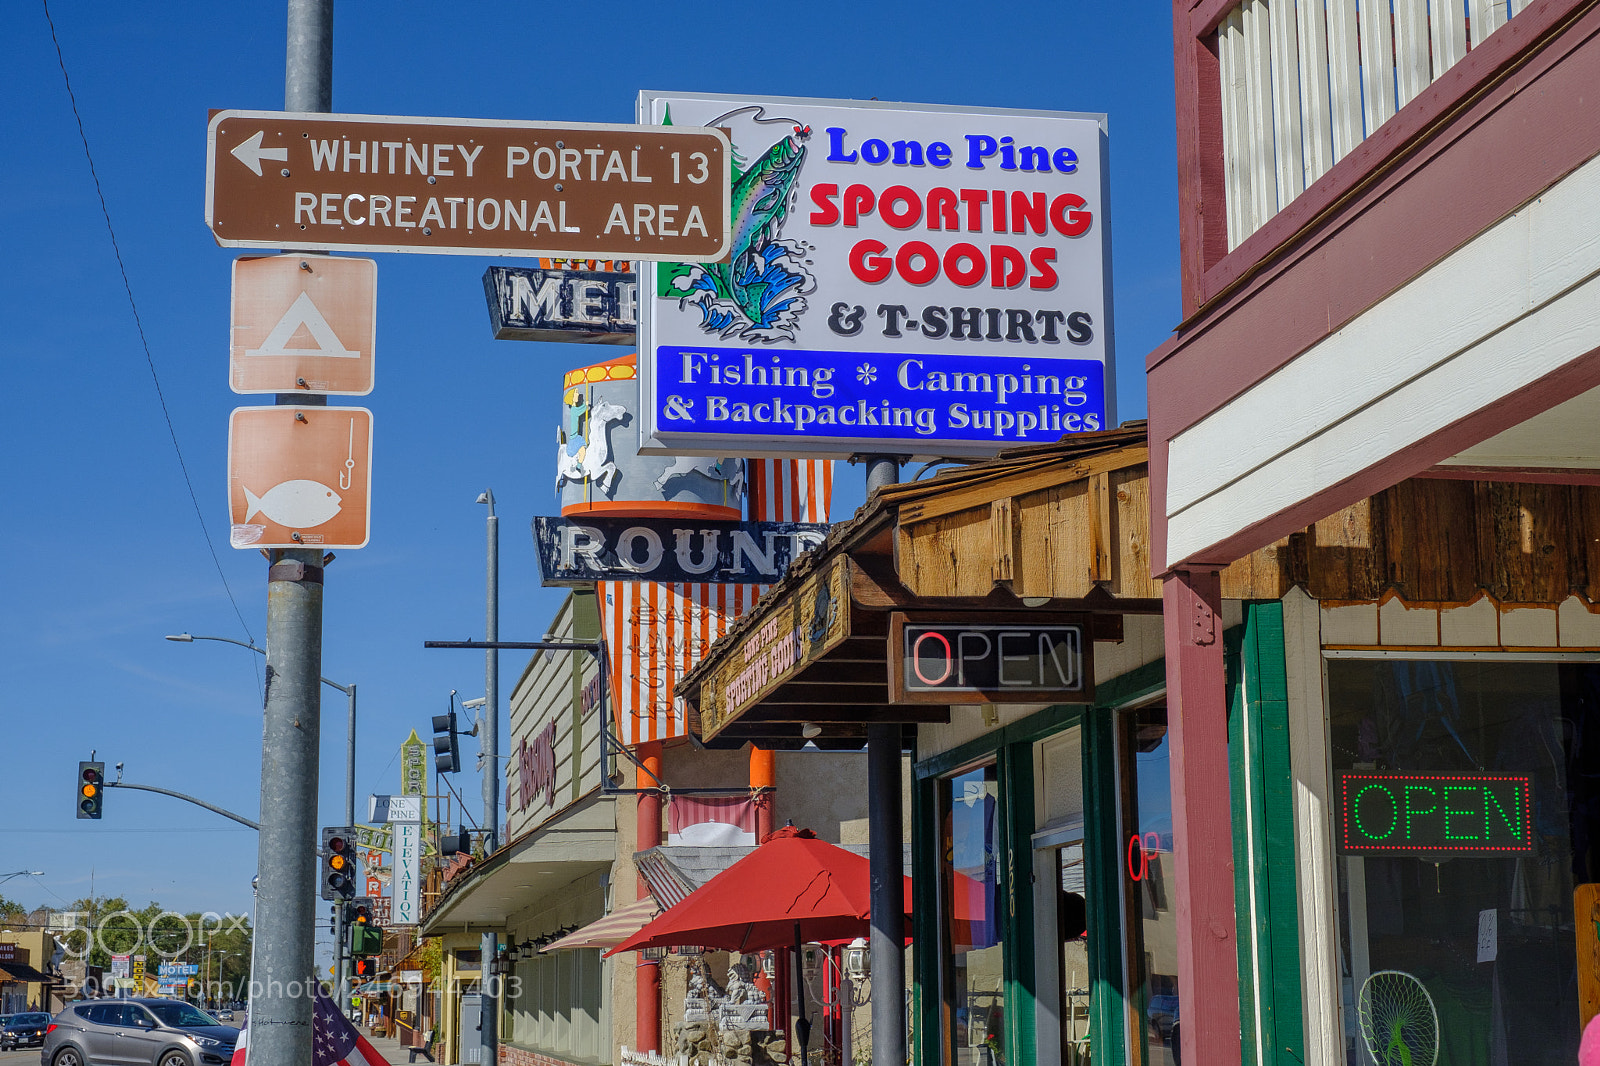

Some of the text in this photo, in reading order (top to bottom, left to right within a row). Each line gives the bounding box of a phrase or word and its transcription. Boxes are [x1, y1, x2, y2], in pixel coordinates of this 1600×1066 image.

[310, 138, 709, 184] WHITNEY PORTAL 13
[826, 127, 1079, 173] Lone Pine
[294, 191, 709, 238] RECREATIONAL AREA
[809, 183, 1093, 237] SPORTING
[848, 238, 1058, 290] GOODS
[827, 302, 1094, 345] & T-SHIRTS
[678, 352, 1088, 406] Fishing Camping
[662, 394, 1100, 438] & Backpacking Supplies
[760, 616, 778, 648] PINE
[725, 652, 770, 715] SPORTING
[770, 625, 804, 679] GOODS
[913, 631, 1072, 686] OPEN
[375, 799, 406, 808] LONE
[390, 810, 416, 819] PINE
[1355, 784, 1521, 840] OPEN
[400, 826, 413, 922] ELEVATION
[159, 965, 196, 975] MOTEL
